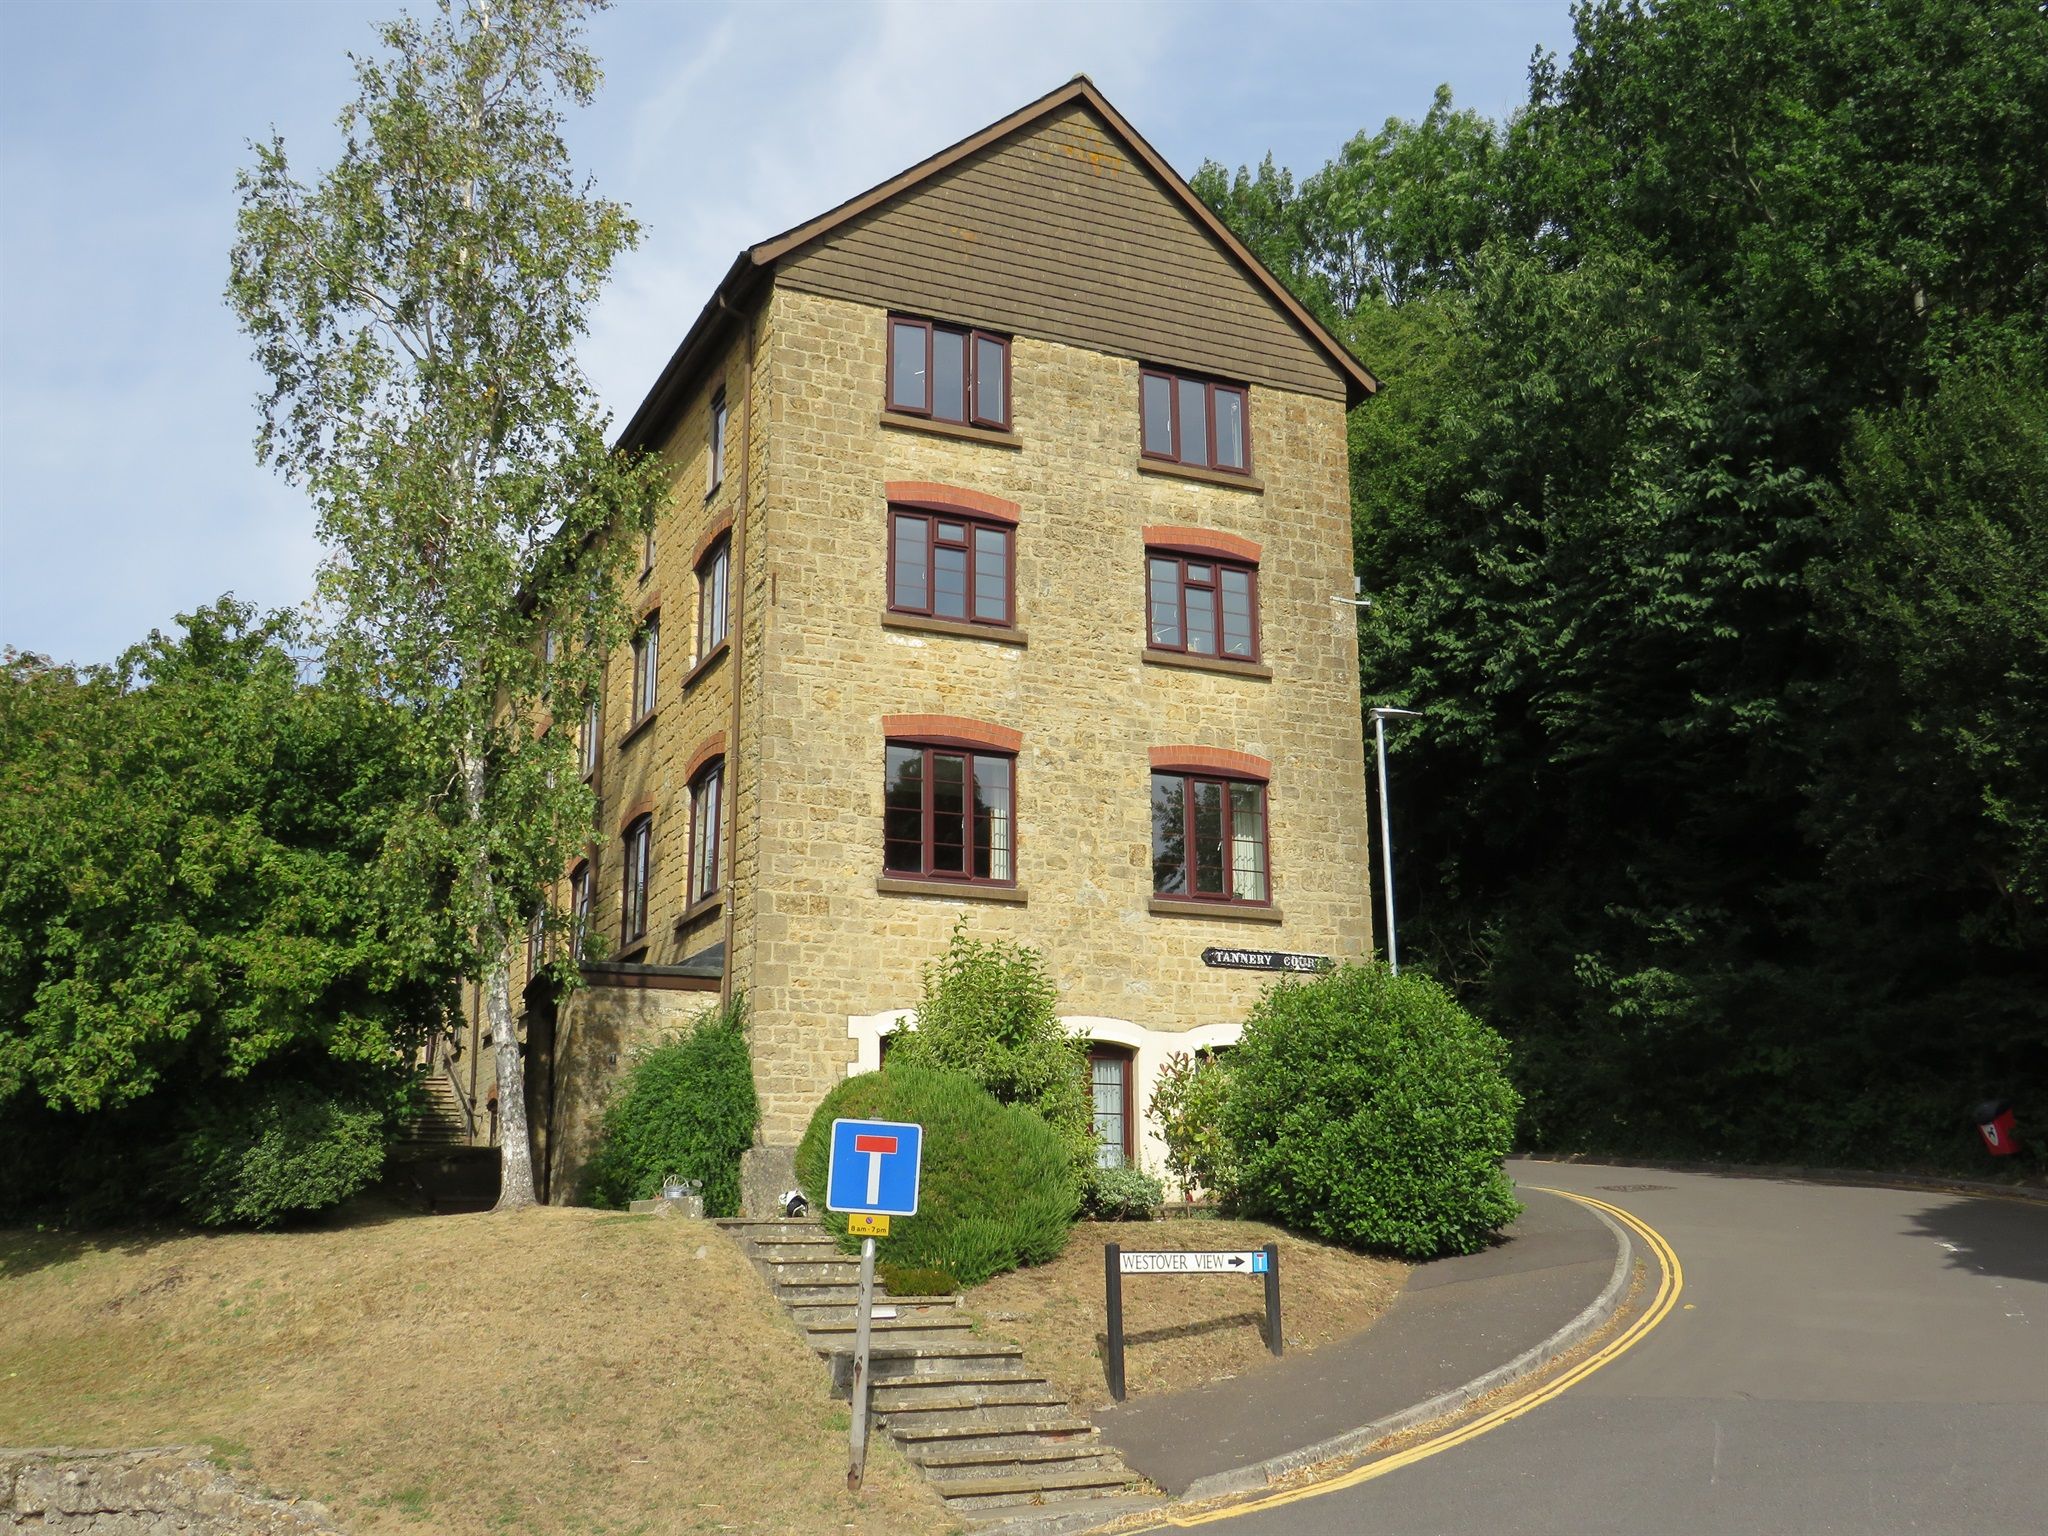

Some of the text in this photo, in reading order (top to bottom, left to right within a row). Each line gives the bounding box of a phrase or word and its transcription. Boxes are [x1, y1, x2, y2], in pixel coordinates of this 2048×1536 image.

[1214, 951, 1273, 966] TANNERY
[1123, 1255, 1225, 1270] WESTOVER VIEW
